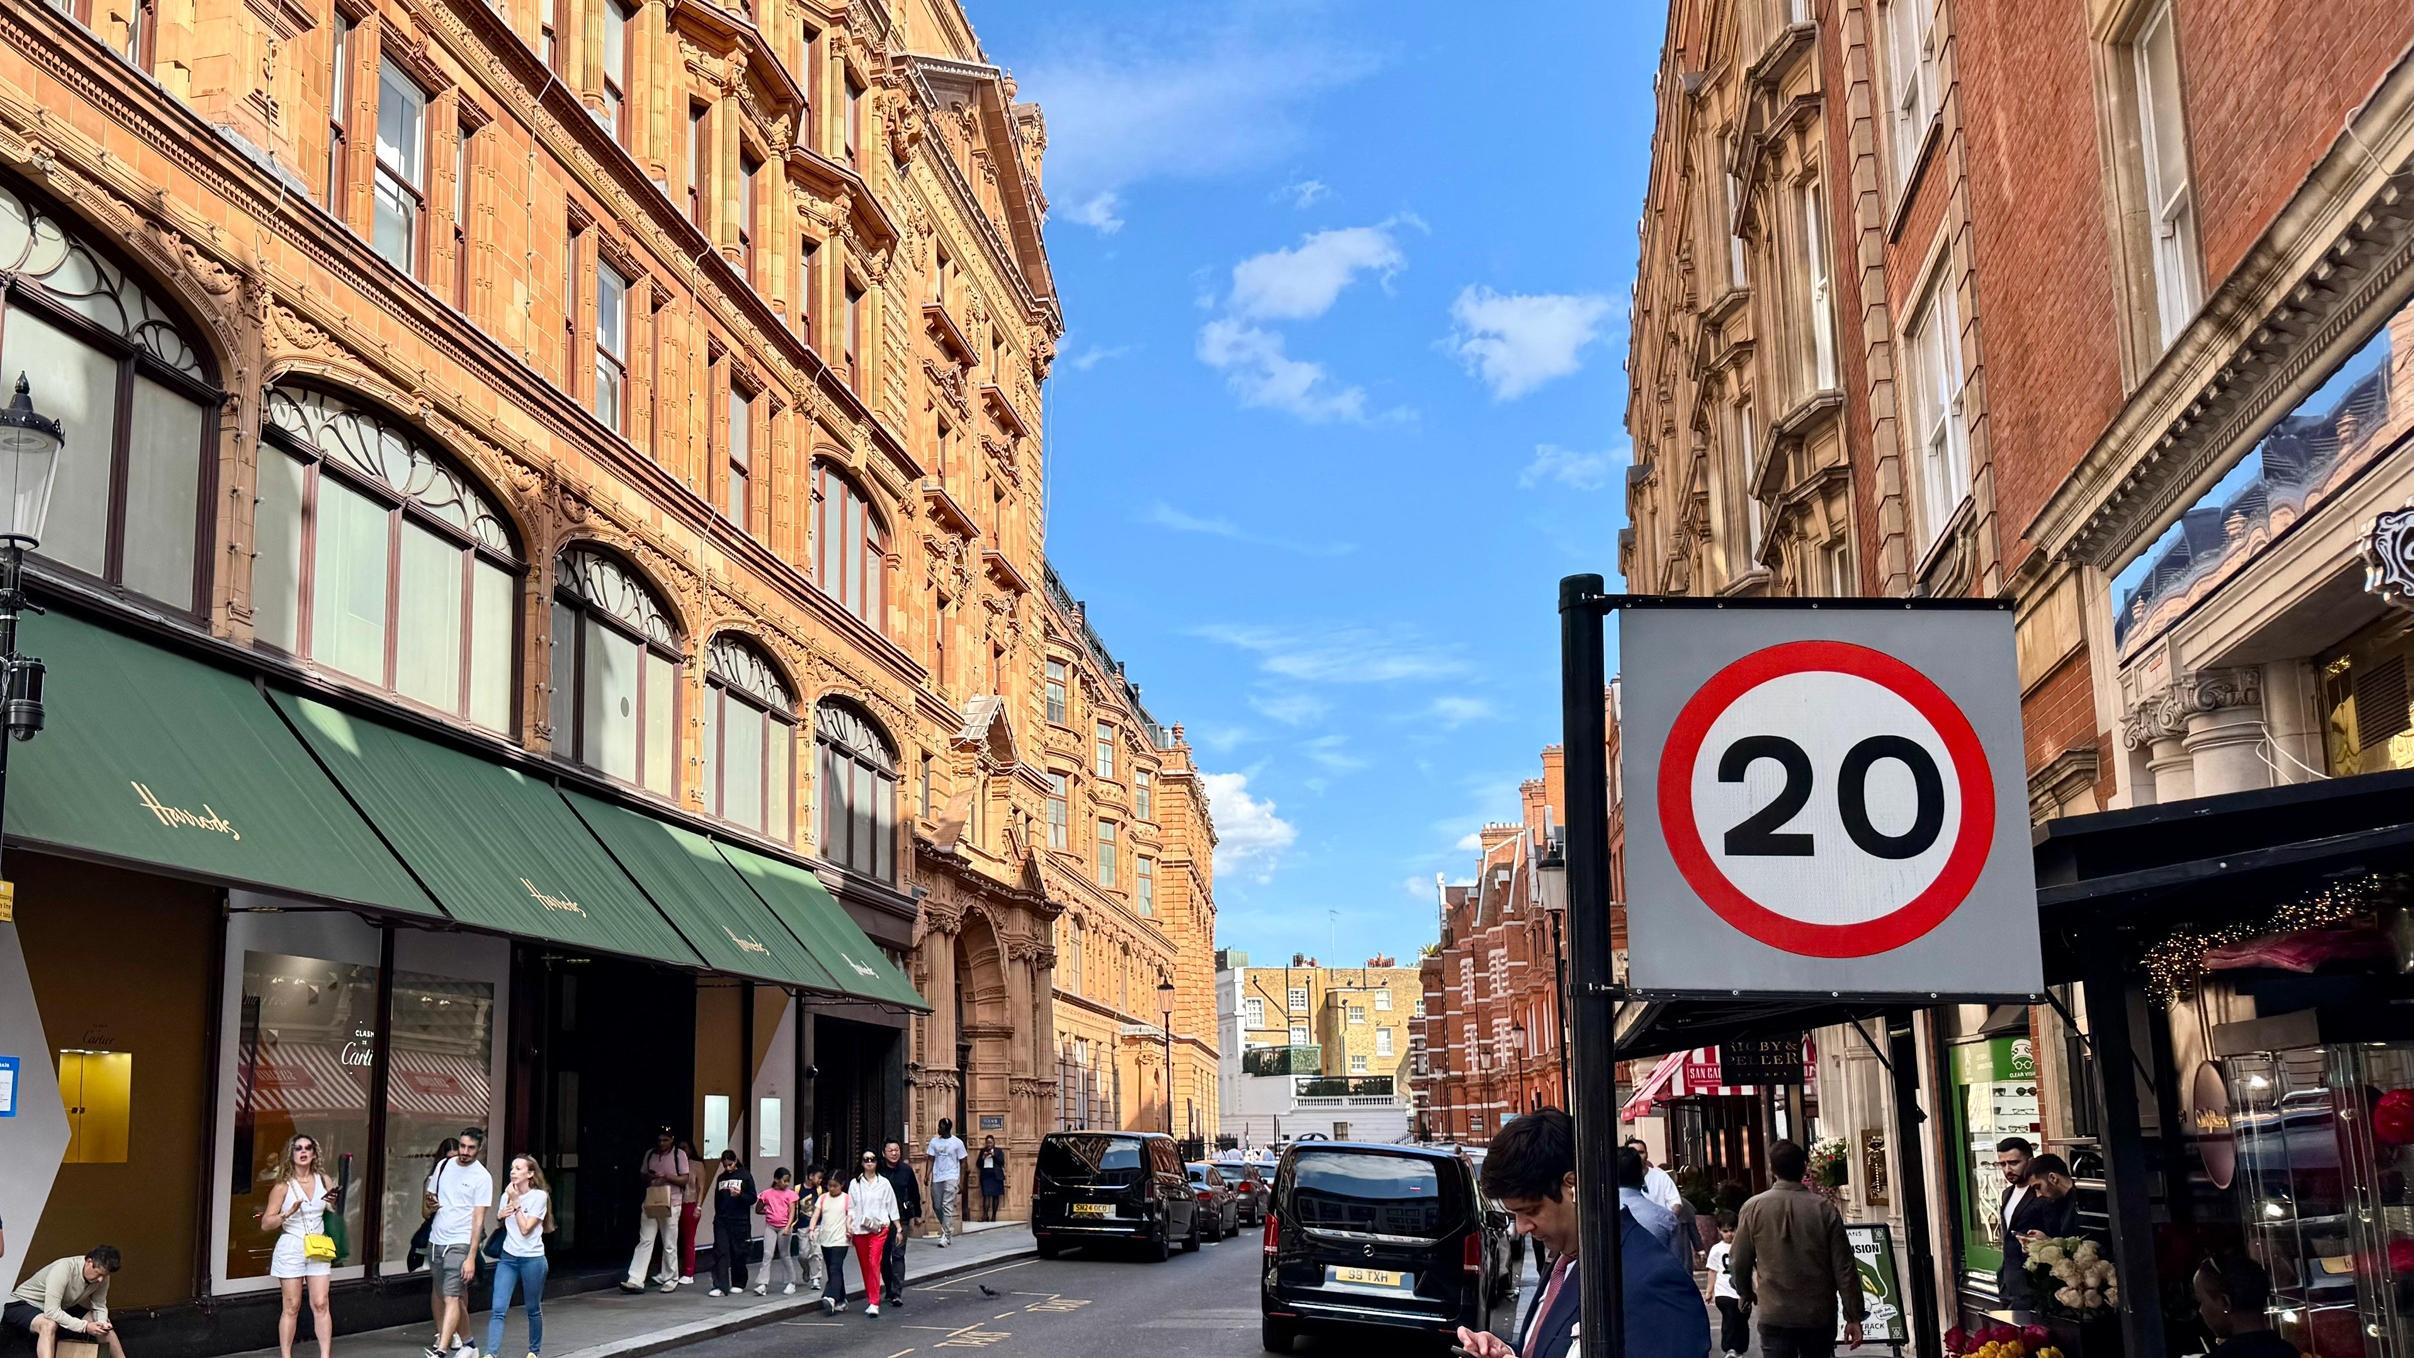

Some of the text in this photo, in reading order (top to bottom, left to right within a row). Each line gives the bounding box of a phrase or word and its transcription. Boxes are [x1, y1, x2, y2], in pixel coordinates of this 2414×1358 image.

[1717, 735, 1945, 860] 20
[131, 780, 240, 841] Harrods
[520, 877, 586, 918] Harrods
[341, 1041, 373, 1066] Carti
[1785, 1041, 1798, 1051] &
[1690, 1067, 1706, 1079] SAN
[1367, 1270, 1388, 1283] TXH
